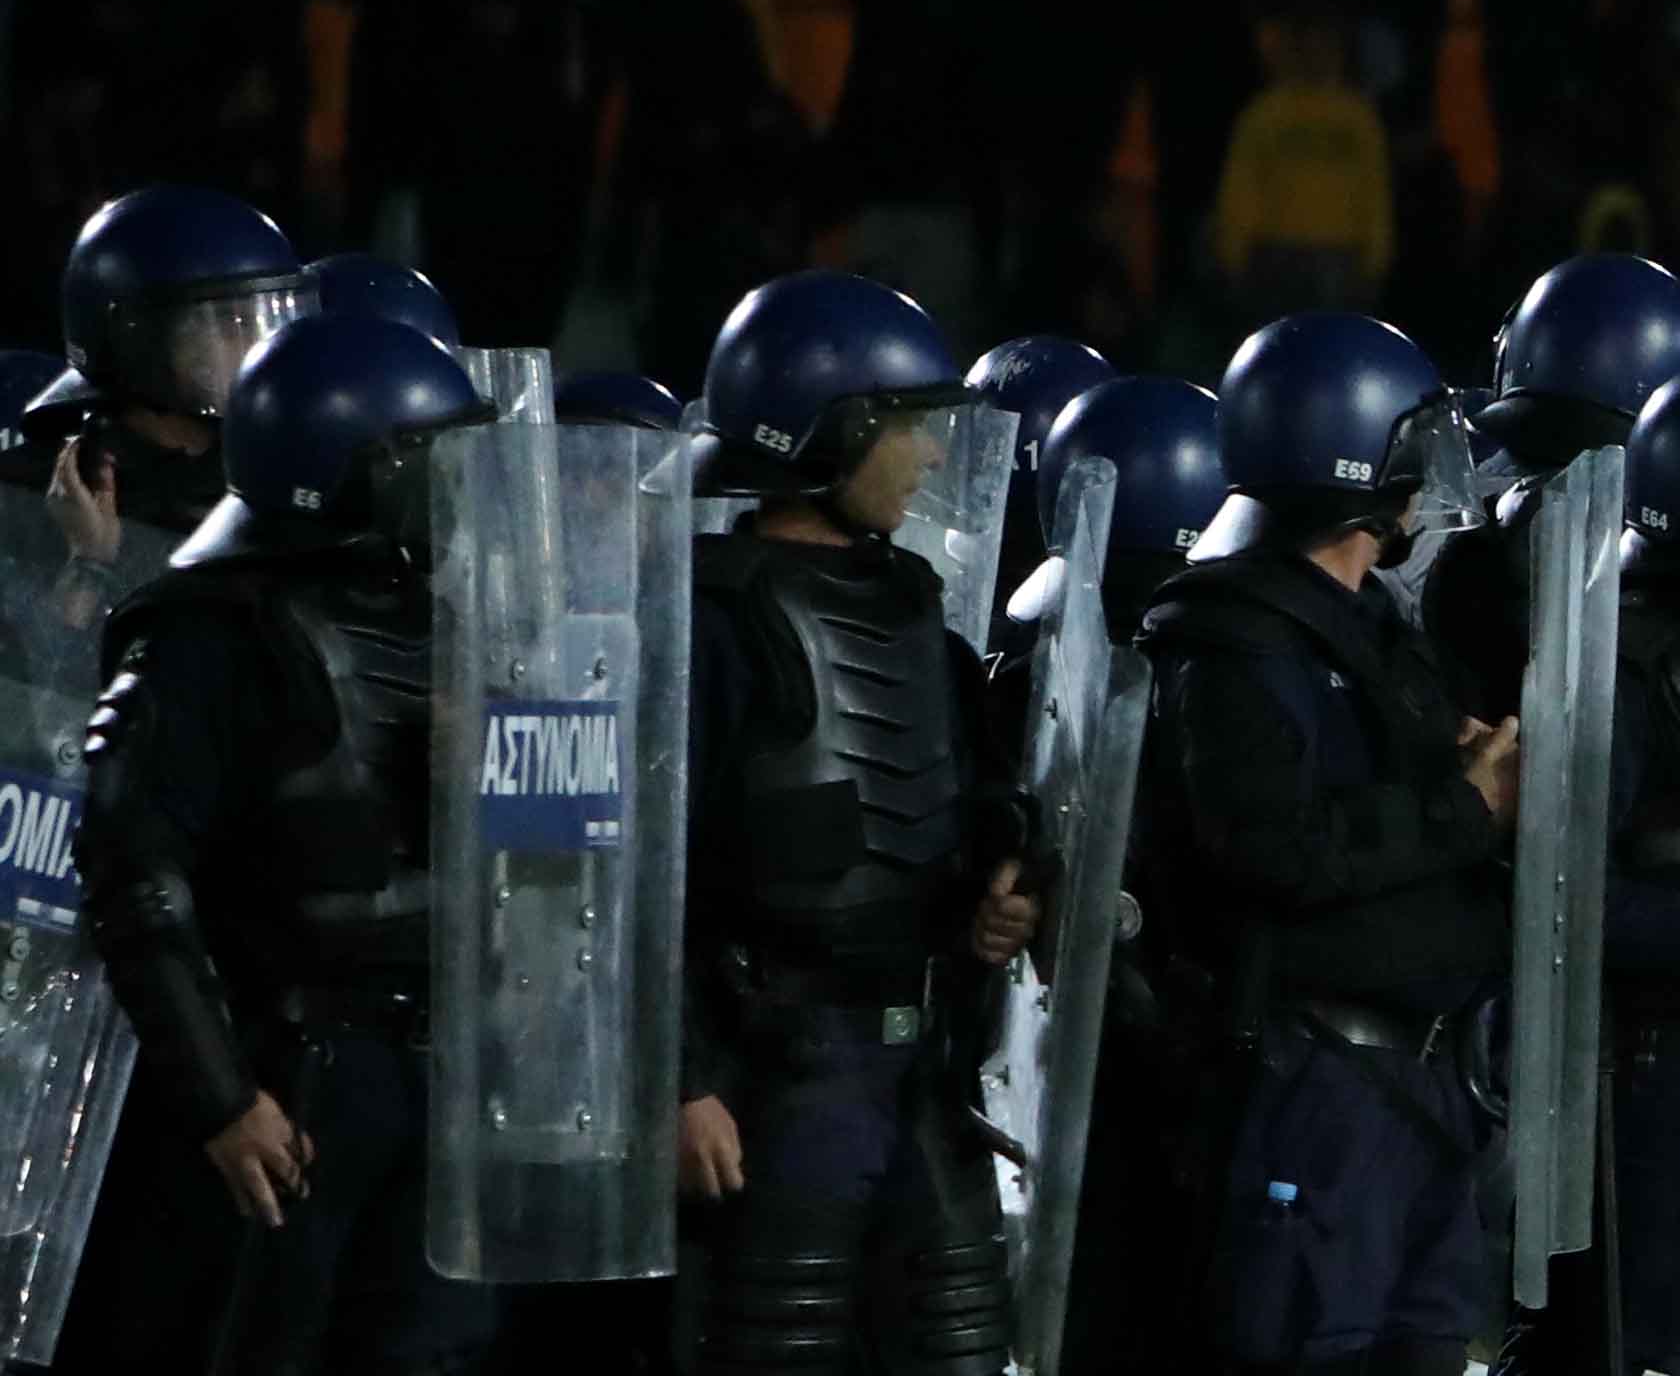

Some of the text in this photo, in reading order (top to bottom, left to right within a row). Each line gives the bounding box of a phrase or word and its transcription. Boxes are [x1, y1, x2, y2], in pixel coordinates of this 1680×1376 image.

[754, 423, 793, 453] E25
[1641, 506, 1669, 531] E64
[480, 715, 620, 795] ΑΣΤΥΝΟΜΙΑ
